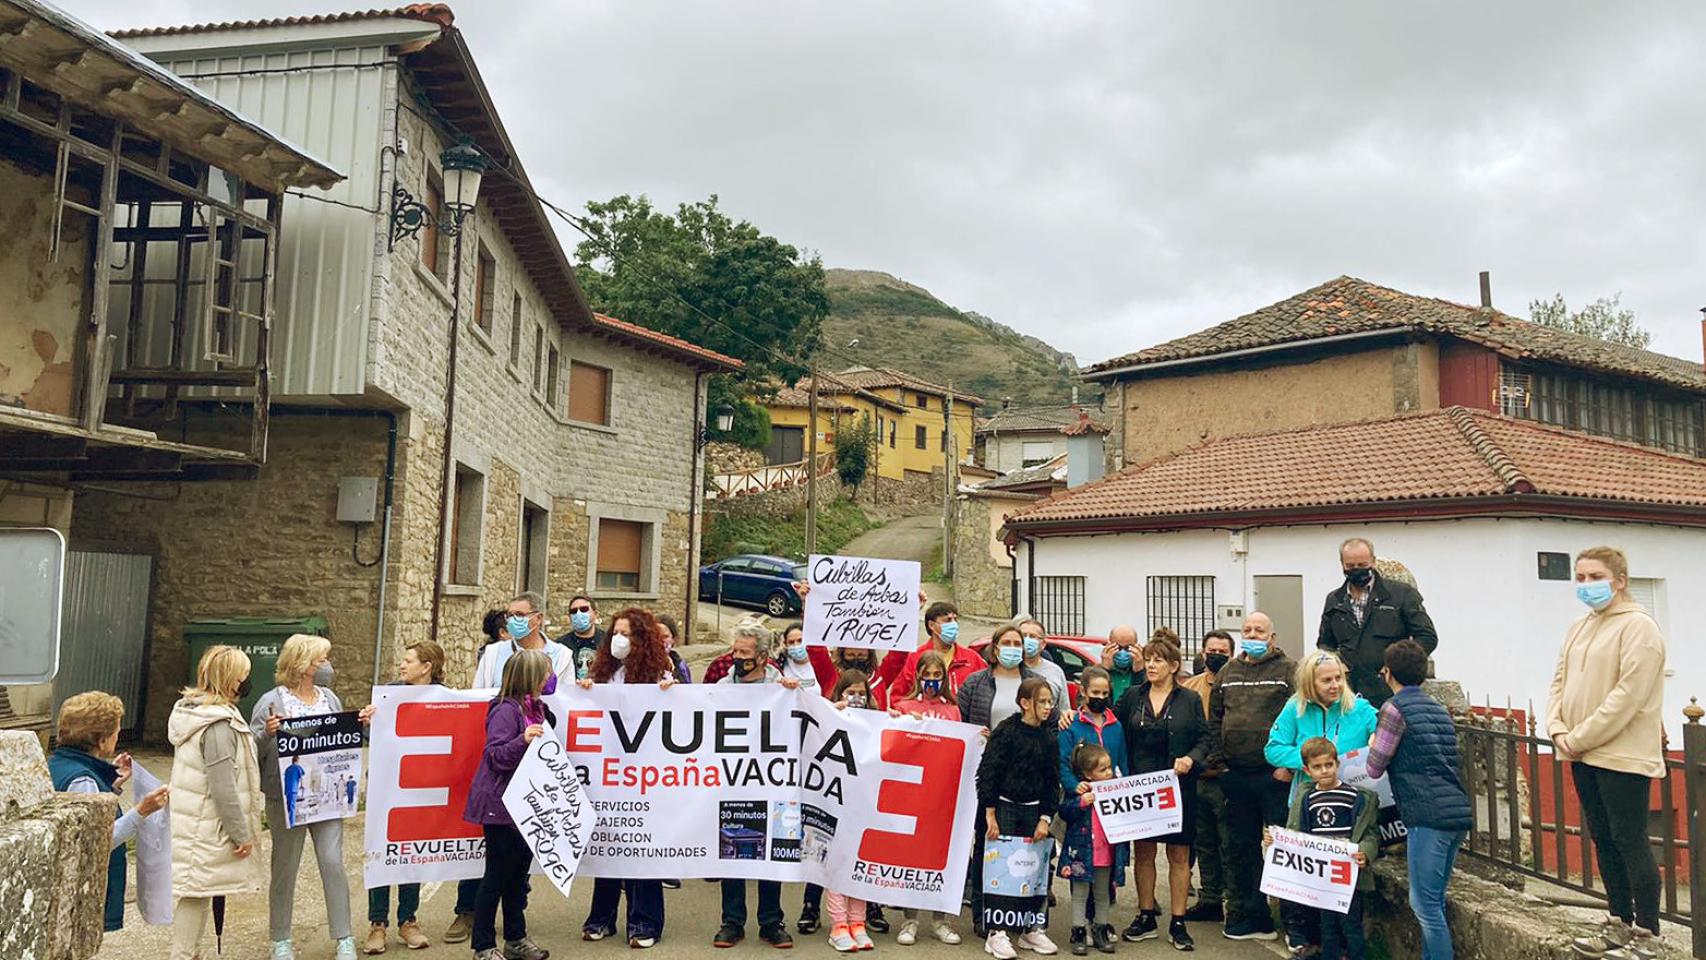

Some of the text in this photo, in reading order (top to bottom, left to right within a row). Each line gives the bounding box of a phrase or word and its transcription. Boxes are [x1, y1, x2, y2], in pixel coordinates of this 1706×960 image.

[813, 557, 887, 585] Cubillas
[838, 583, 908, 604] de Arbas
[292, 717, 322, 729] menos
[324, 715, 337, 725] de
[278, 731, 361, 753] 30 minutos
[574, 757, 844, 806] a EspañaVACIDA
[1096, 774, 1171, 794] EspañaVACIADA
[720, 810, 767, 820] 30 minutos
[386, 838, 487, 856] REVUELTA
[591, 831, 652, 843] OBLACION
[1275, 831, 1349, 856] EspañaVACIADA
[385, 857, 398, 866] de
[400, 855, 409, 865] la
[590, 846, 604, 856] DE
[607, 846, 707, 858] OPORTUNIDADES
[854, 860, 945, 885] REVUELTA
[851, 873, 942, 893] de la EspañaVACIADA
